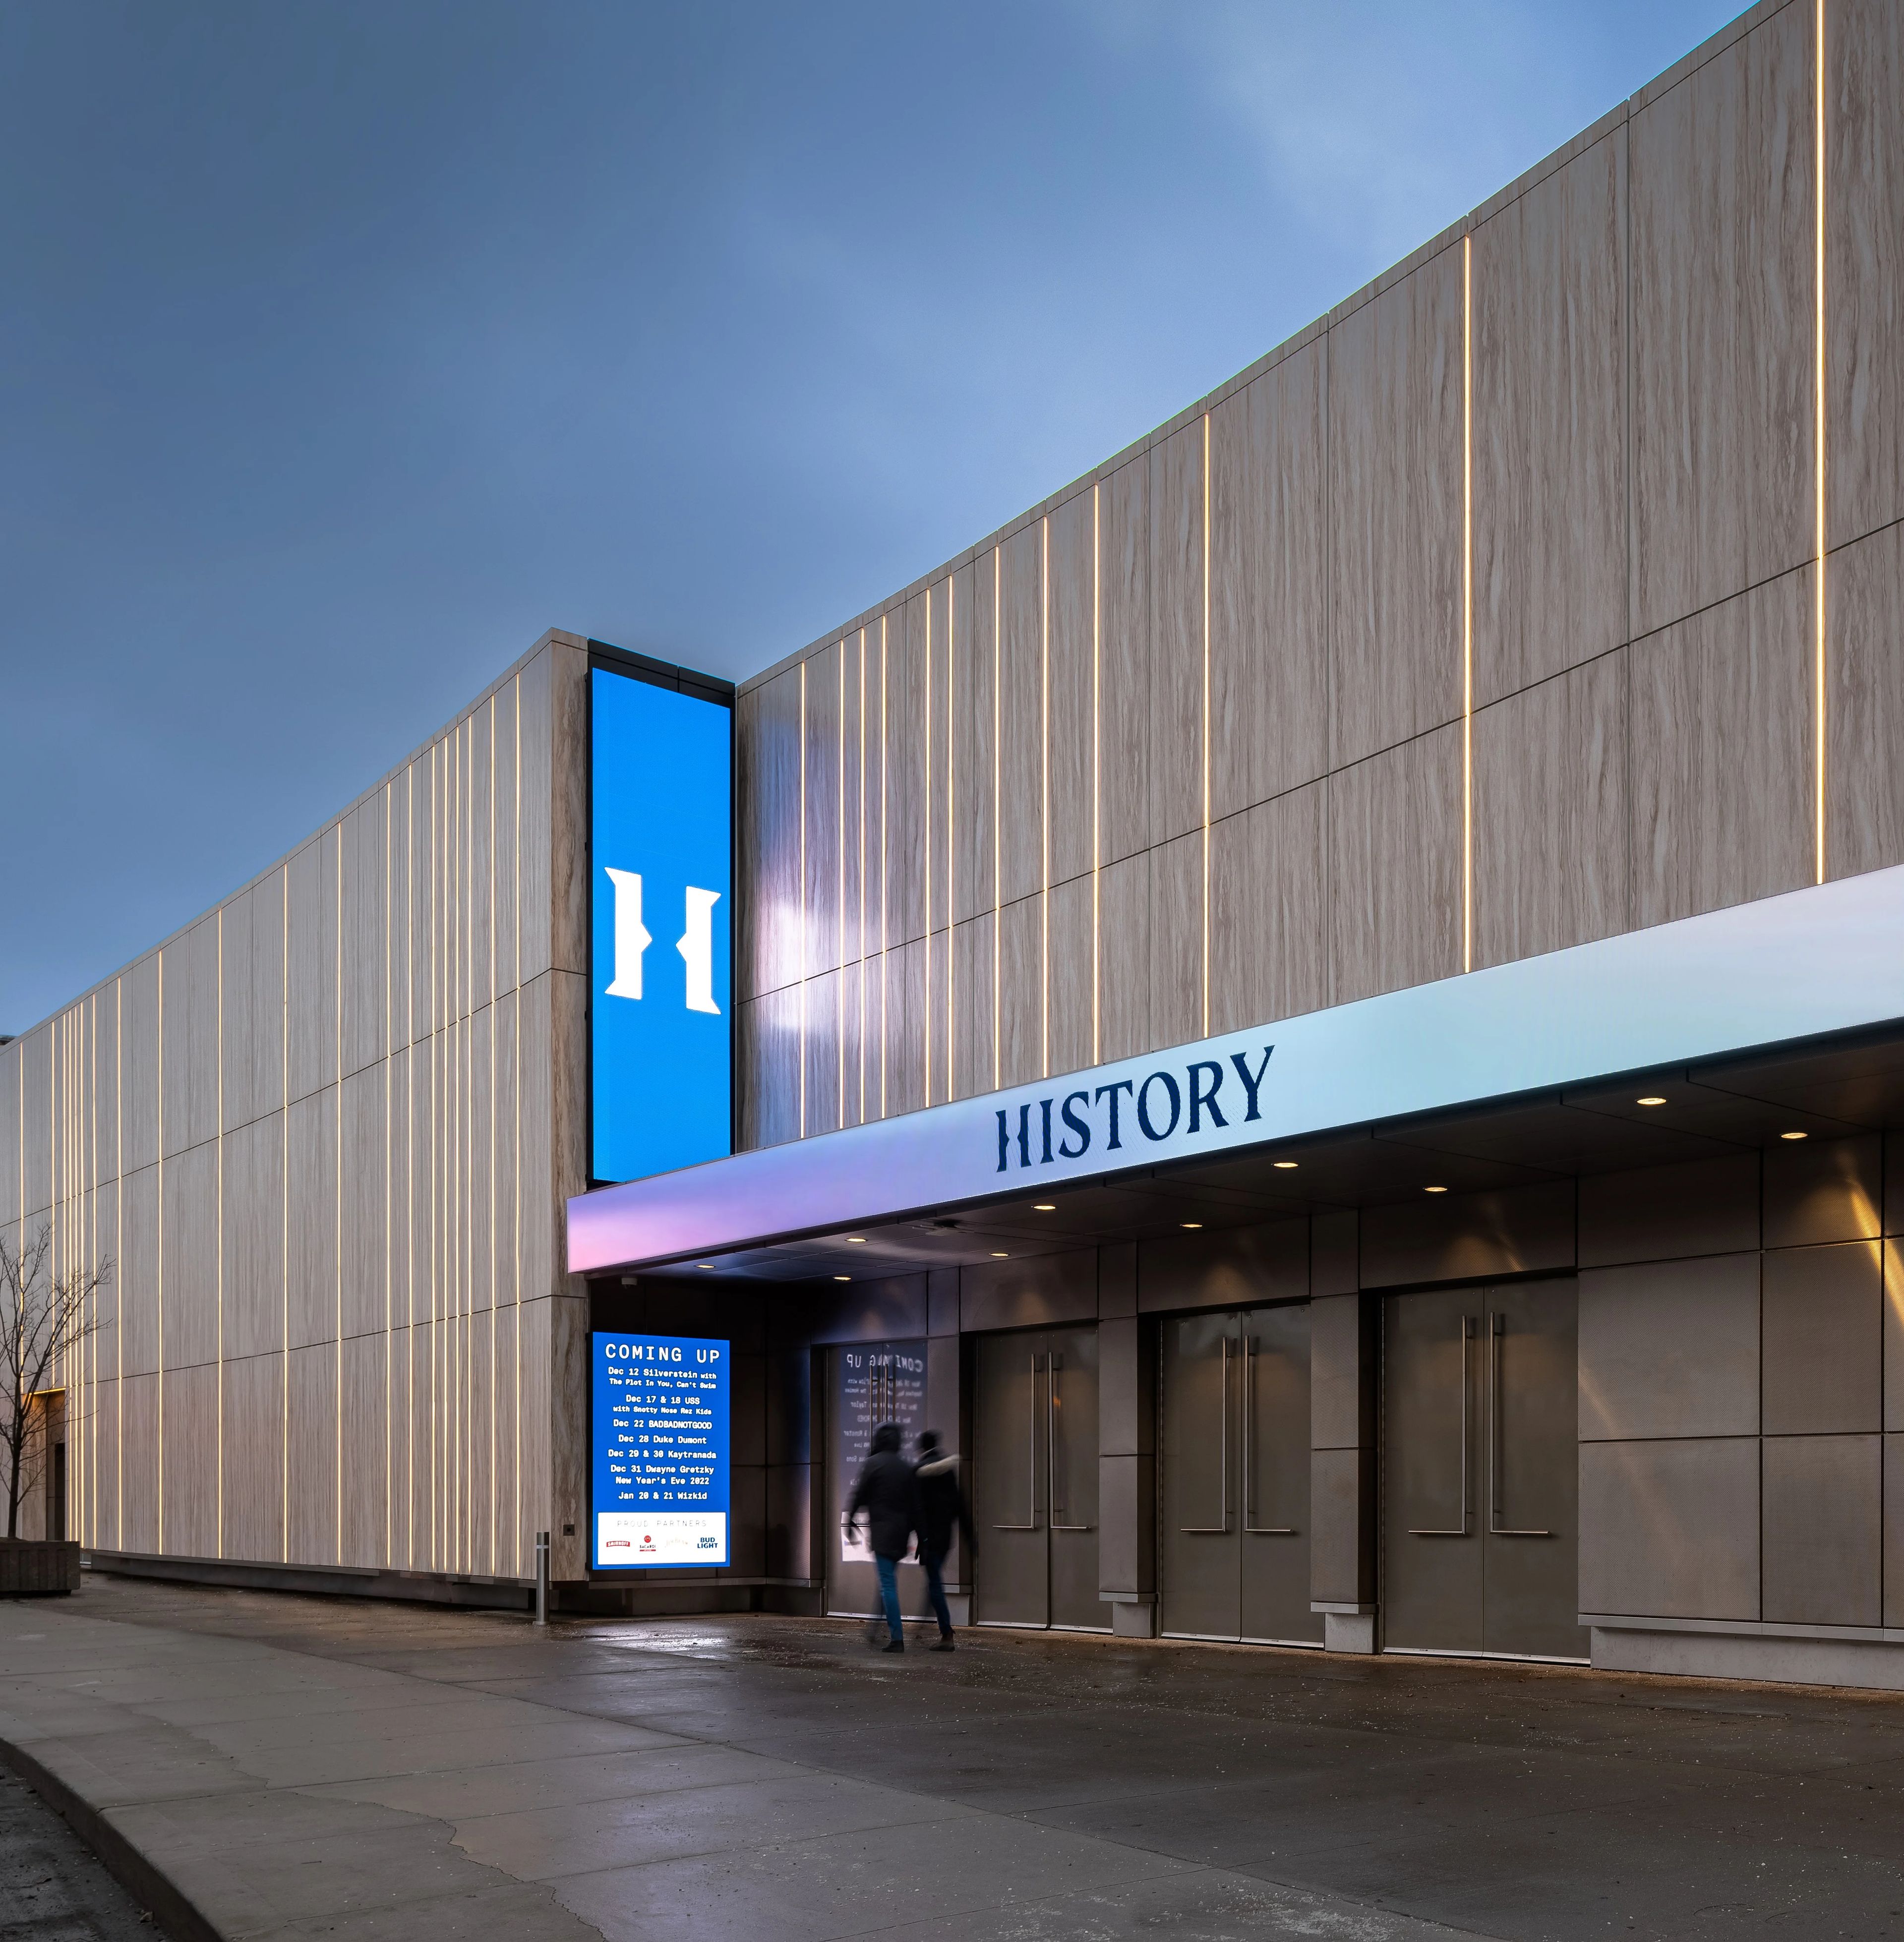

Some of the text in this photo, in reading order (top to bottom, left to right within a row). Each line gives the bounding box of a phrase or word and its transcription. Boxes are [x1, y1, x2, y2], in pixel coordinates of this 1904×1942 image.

[996, 1045, 1275, 1173] HISTORY
[605, 1344, 719, 1363] COMING UP
[608, 1366, 624, 1375] Dec
[643, 1368, 698, 1379] Silverstein
[626, 1394, 641, 1403] Dec
[633, 1406, 658, 1414] Snotty
[649, 1420, 713, 1429] BADBADNOTGOOD
[653, 1435, 674, 1443] Duke
[678, 1436, 707, 1444] Dumont
[608, 1449, 624, 1457] Dec
[668, 1450, 716, 1460] Kaytranada
[610, 1464, 626, 1472] Dec
[646, 1465, 676, 1474] Dwayne
[680, 1465, 714, 1475] Gretzky
